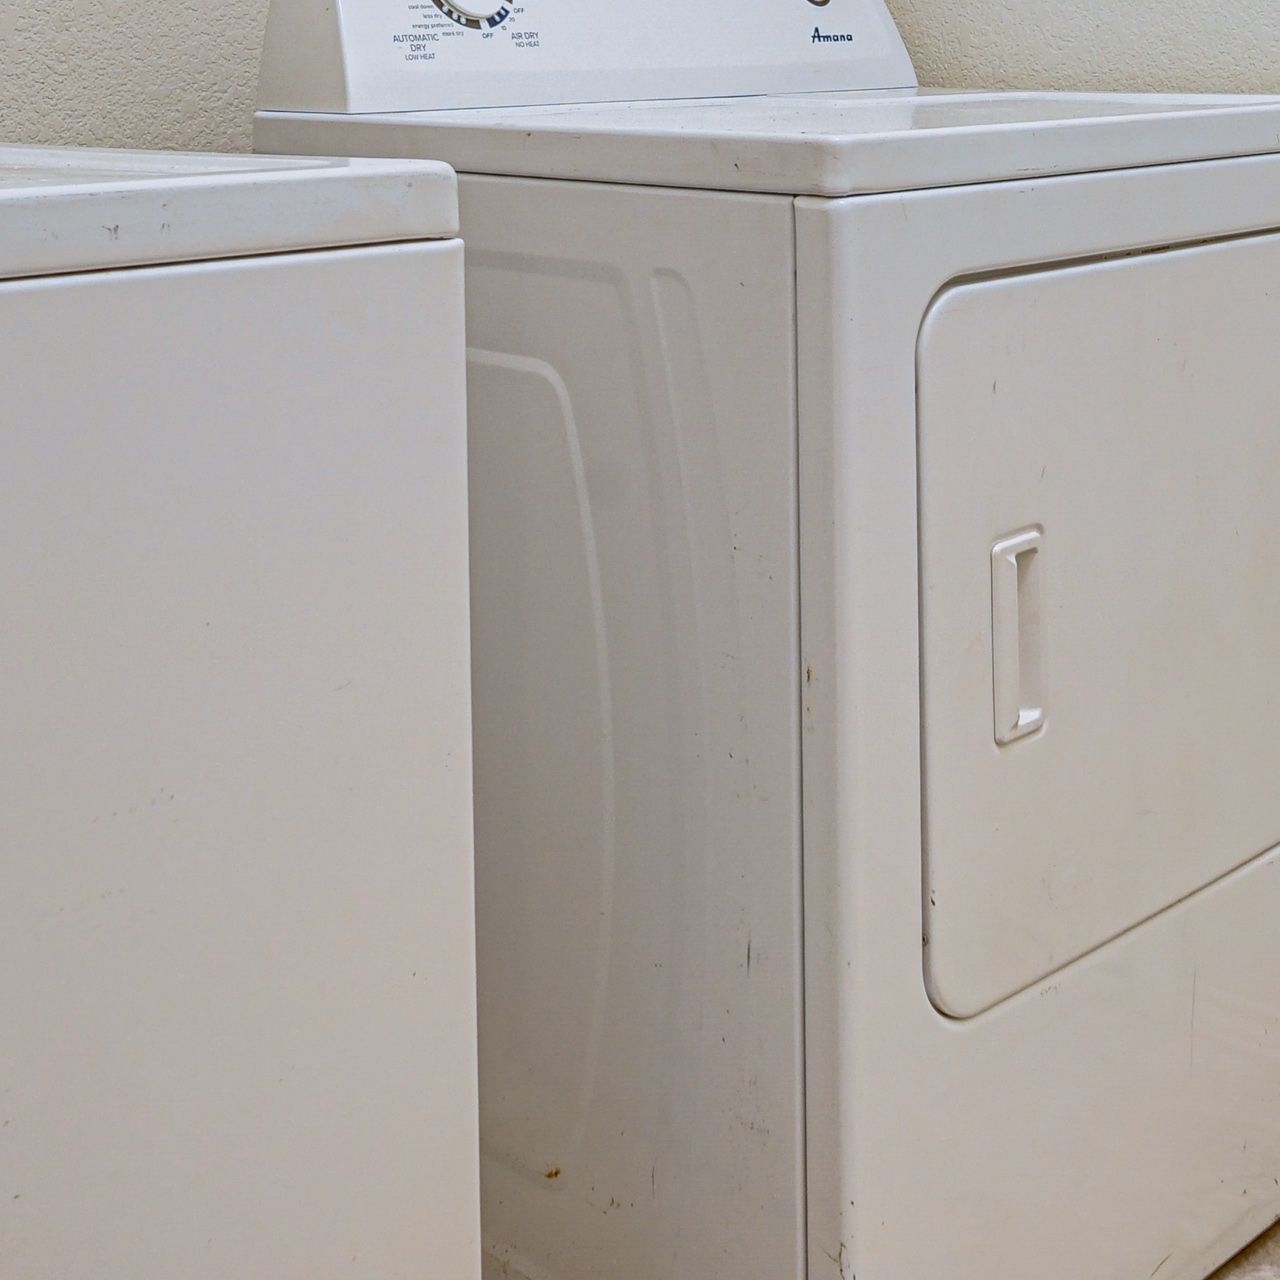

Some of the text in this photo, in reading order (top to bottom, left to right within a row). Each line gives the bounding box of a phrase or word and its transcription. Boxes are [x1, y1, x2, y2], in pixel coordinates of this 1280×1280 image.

[393, 34, 439, 42] AUTOMATIC
[512, 32, 539, 40] AIR DRY
[811, 26, 853, 44] Amana
[410, 43, 426, 52] DRY
[405, 53, 435, 61] LOW HEAT
